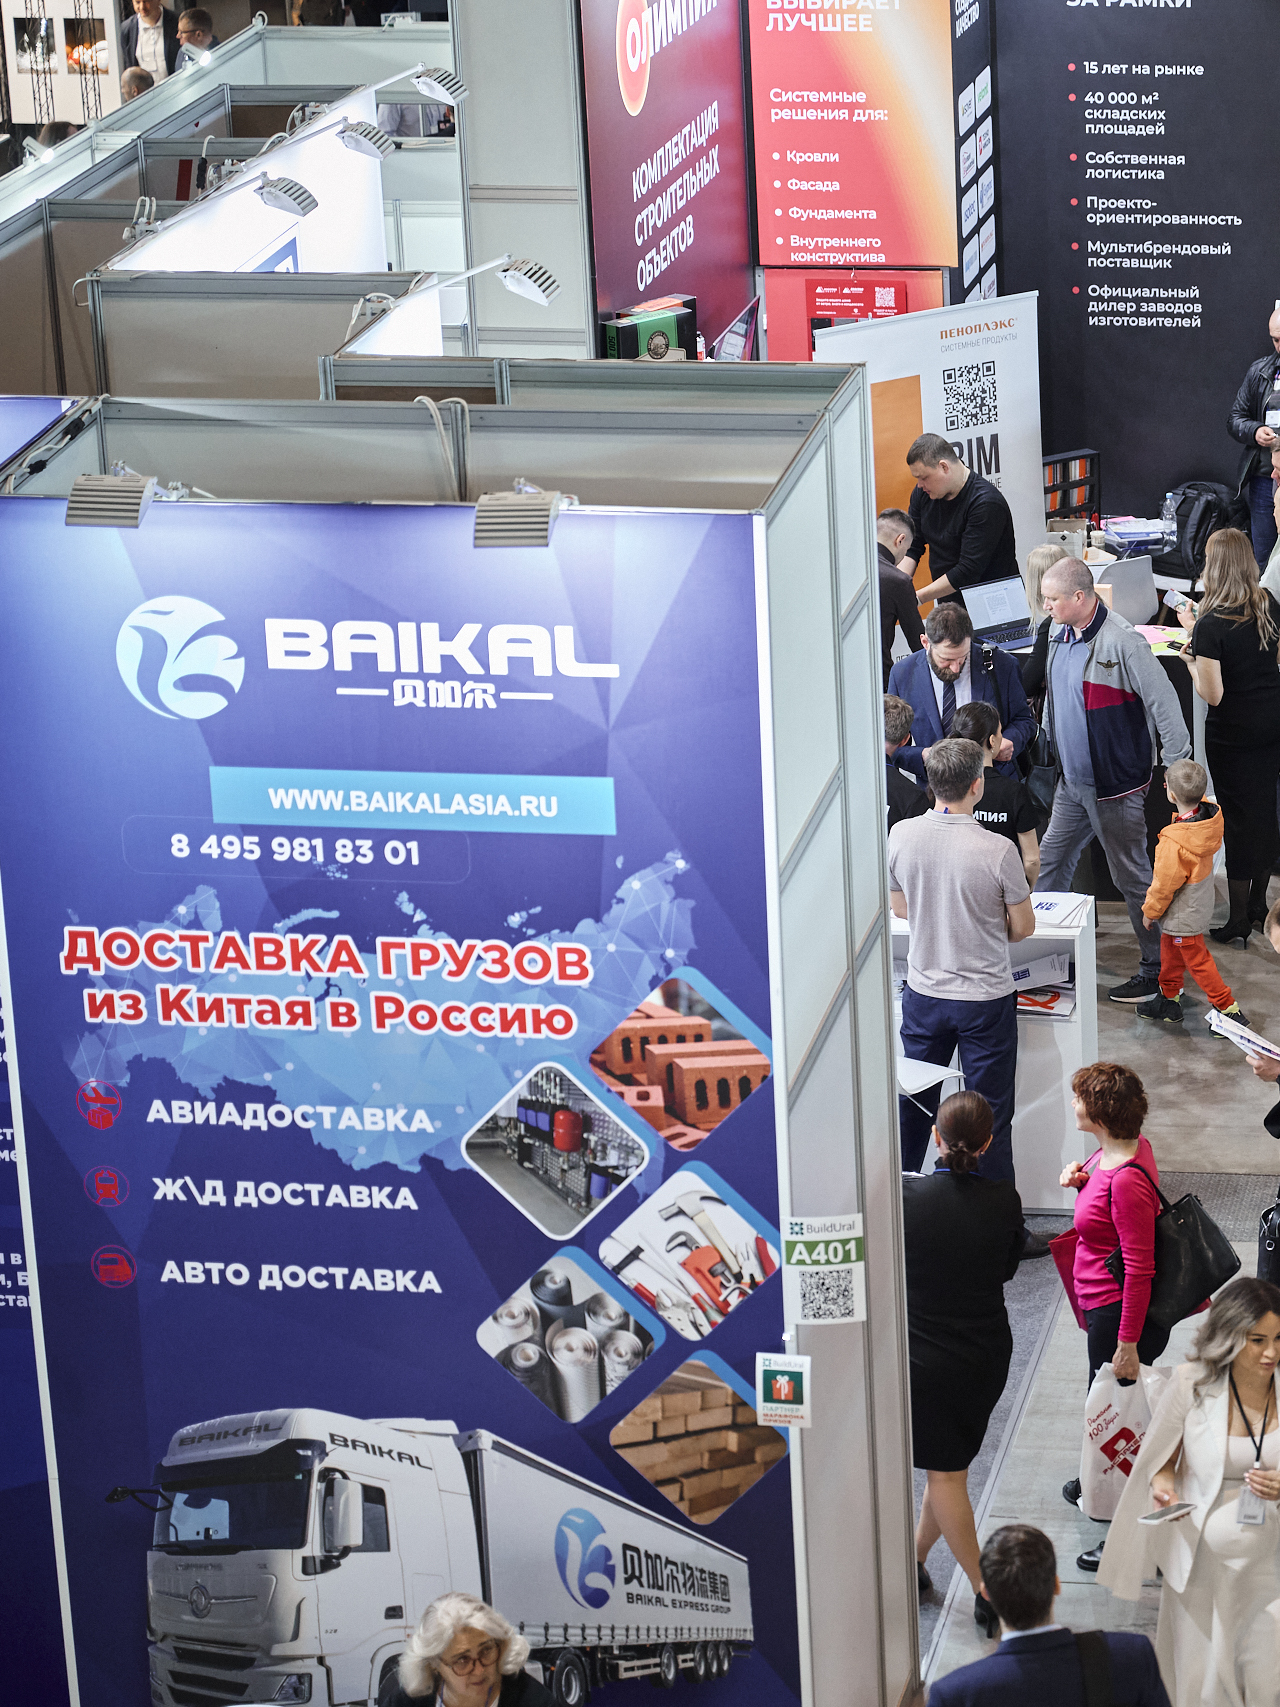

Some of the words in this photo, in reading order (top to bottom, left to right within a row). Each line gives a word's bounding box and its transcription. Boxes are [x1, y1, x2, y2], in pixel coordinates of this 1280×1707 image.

[766, 13, 873, 32] ЛУЧШЕЕ
[626, 0, 718, 72] ОЛИМП
[1083, 61, 1098, 74] 15
[1101, 63, 1128, 75] лет
[1132, 64, 1150, 75] на
[1154, 64, 1205, 77] рынке
[769, 88, 867, 103] Системные
[1084, 92, 1104, 104] 40
[1107, 92, 1138, 105] 000
[770, 108, 849, 123] решения
[852, 109, 889, 122] для:
[1084, 109, 1166, 121] складских
[1085, 122, 1165, 136] площадей
[631, 100, 720, 203] КОМПЛЕКТАЦИЯ
[786, 150, 840, 164] Кровли
[1085, 151, 1186, 165] Собственная
[1085, 168, 1165, 180] логистика
[787, 178, 840, 192] Фасада
[634, 144, 721, 247] СТРОИТЕЛЬНЫХ
[1086, 196, 1157, 211] Проекто-
[788, 206, 877, 221] Фундамента
[1086, 213, 1243, 226] ориентированность
[790, 235, 882, 249] Внутреннего
[1087, 240, 1232, 256] Мультибрендовый
[636, 214, 695, 292] ОБЪЕКТОВ
[790, 252, 886, 265] конструктива
[1087, 257, 1172, 270] поставщик
[1087, 284, 1200, 299] Официальный
[1087, 301, 1137, 314] дилер
[1139, 302, 1203, 314] заводов
[940, 318, 1015, 340] ПЕНОПЛЭКС
[1088, 315, 1202, 328] изготовителей
[940, 339, 981, 353] СИСТЕМНЫЕ
[981, 332, 1018, 346] ПРОДУКТЫ
[264, 618, 620, 678] BAIKAL
[393, 679, 497, 709] 贝加尔
[268, 788, 558, 817] WWW.BAIKALASIA.RU
[973, 811, 1008, 823] МПИЯ
[170, 834, 190, 858] 8
[200, 834, 261, 861] 495
[271, 836, 325, 862] 981
[334, 839, 374, 864] 83
[383, 840, 419, 866] 01
[61, 928, 367, 978] ДОСТАВКА
[377, 936, 593, 985] ГРУЗОВ
[85, 988, 146, 1023] из
[157, 984, 314, 1030] Китая
[326, 996, 358, 1030] в
[371, 992, 578, 1039] Россию
[146, 1099, 435, 1133] АВИАДОСТАВКА
[152, 1176, 226, 1206] Ж\Д
[234, 1180, 418, 1210] ДОСТАВКА
[806, 1220, 855, 1234] BuildUral
[790, 1239, 857, 1264] A401
[160, 1260, 250, 1286] АВТО
[258, 1264, 443, 1294] ДОСТАВКА
[762, 1405, 800, 1414] ПАРТНЕР
[178, 1422, 283, 1448] BAIKAL
[1089, 1423, 1103, 1440] 100
[328, 1432, 433, 1471] BAIKAL
[1103, 1431, 1146, 1475] РУСПАНЕЛ
[622, 1542, 731, 1603] 贝加尔物流集团
[626, 1592, 671, 1609] BAIKAL
[671, 1599, 710, 1613] EXPRESS
[710, 1604, 731, 1614] GROUP
